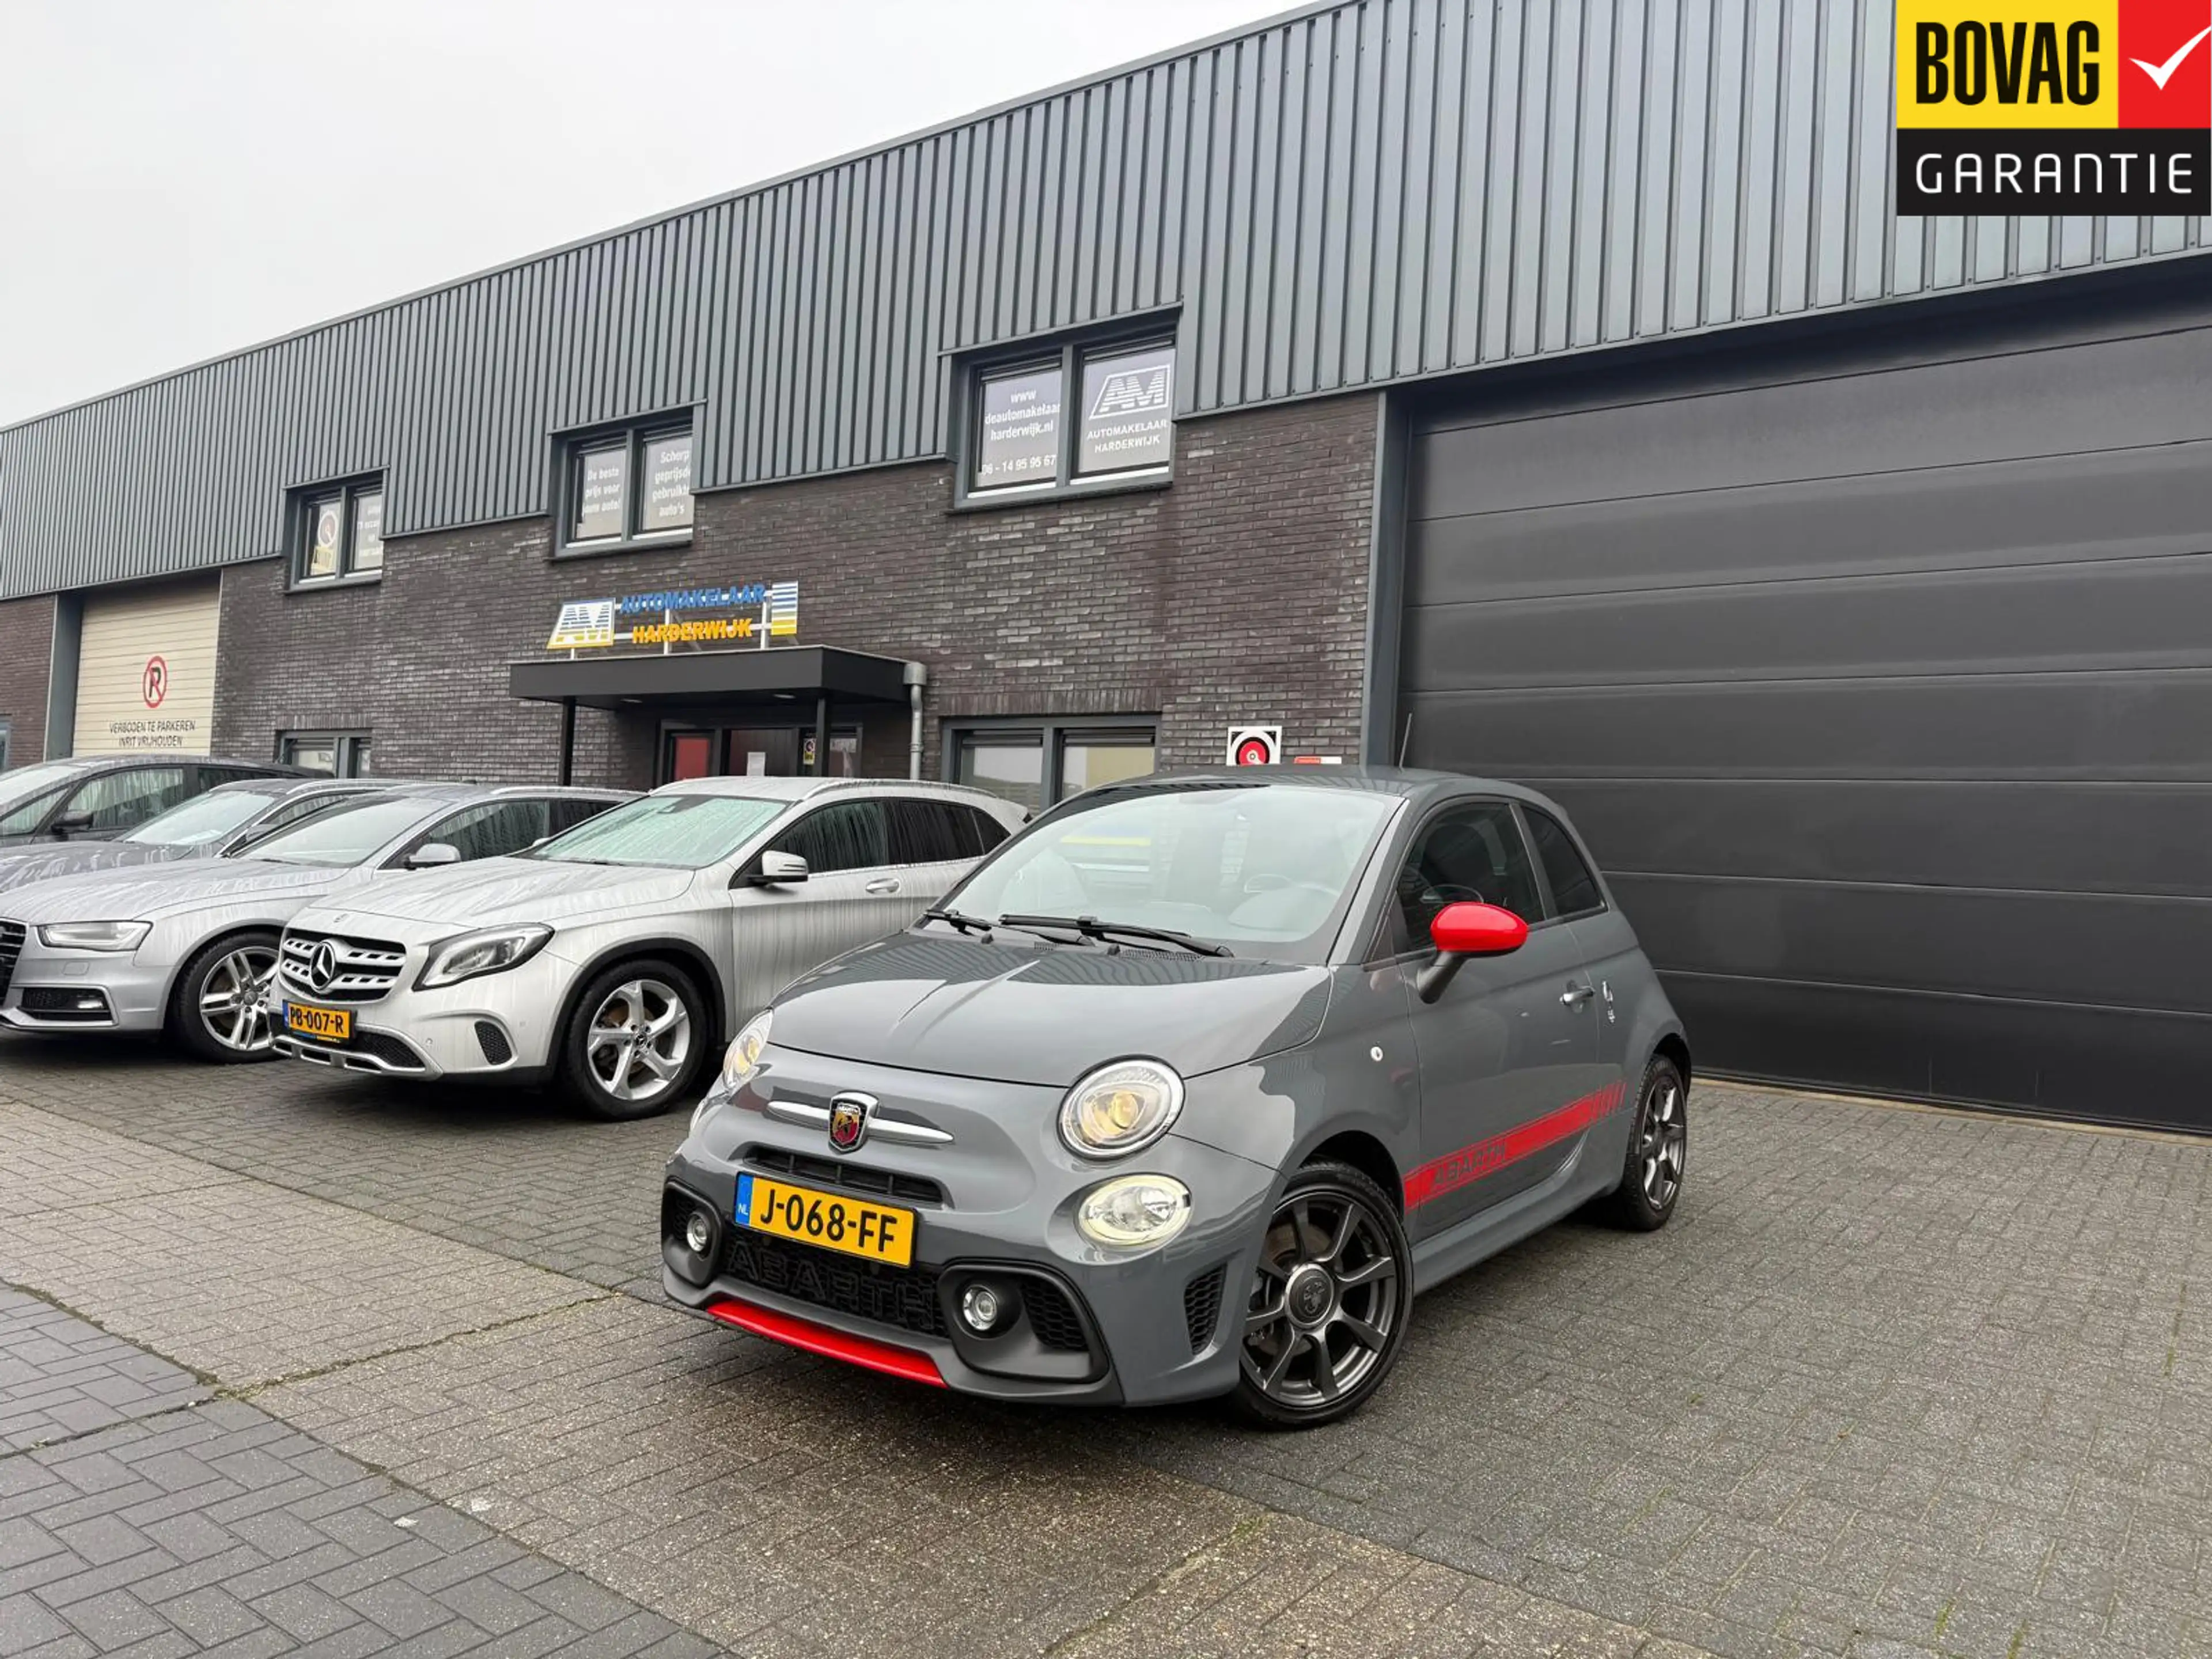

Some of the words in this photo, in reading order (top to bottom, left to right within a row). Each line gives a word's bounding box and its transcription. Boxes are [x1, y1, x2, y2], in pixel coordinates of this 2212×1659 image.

[1010, 390, 1036, 403] www
[991, 419, 1054, 441] harderwijk.nl
[1087, 419, 1168, 440] AUTOMAKELAAR
[1094, 435, 1161, 453] HARDERWIJK
[1002, 461, 1013, 472] 14
[620, 584, 767, 614] AUTOMAKELAAR
[632, 618, 753, 644] HARDERWIJK
[109, 721, 145, 734] VERBODEN
[147, 721, 156, 732] TE
[157, 720, 196, 732] PARKEREN
[290, 1006, 344, 1033] PB-007-R
[1434, 1139, 1506, 1185] ABARTH
[738, 1203, 749, 1215] NL
[760, 1189, 897, 1252] J-068-FF
[729, 1241, 935, 1330] ABARTH
